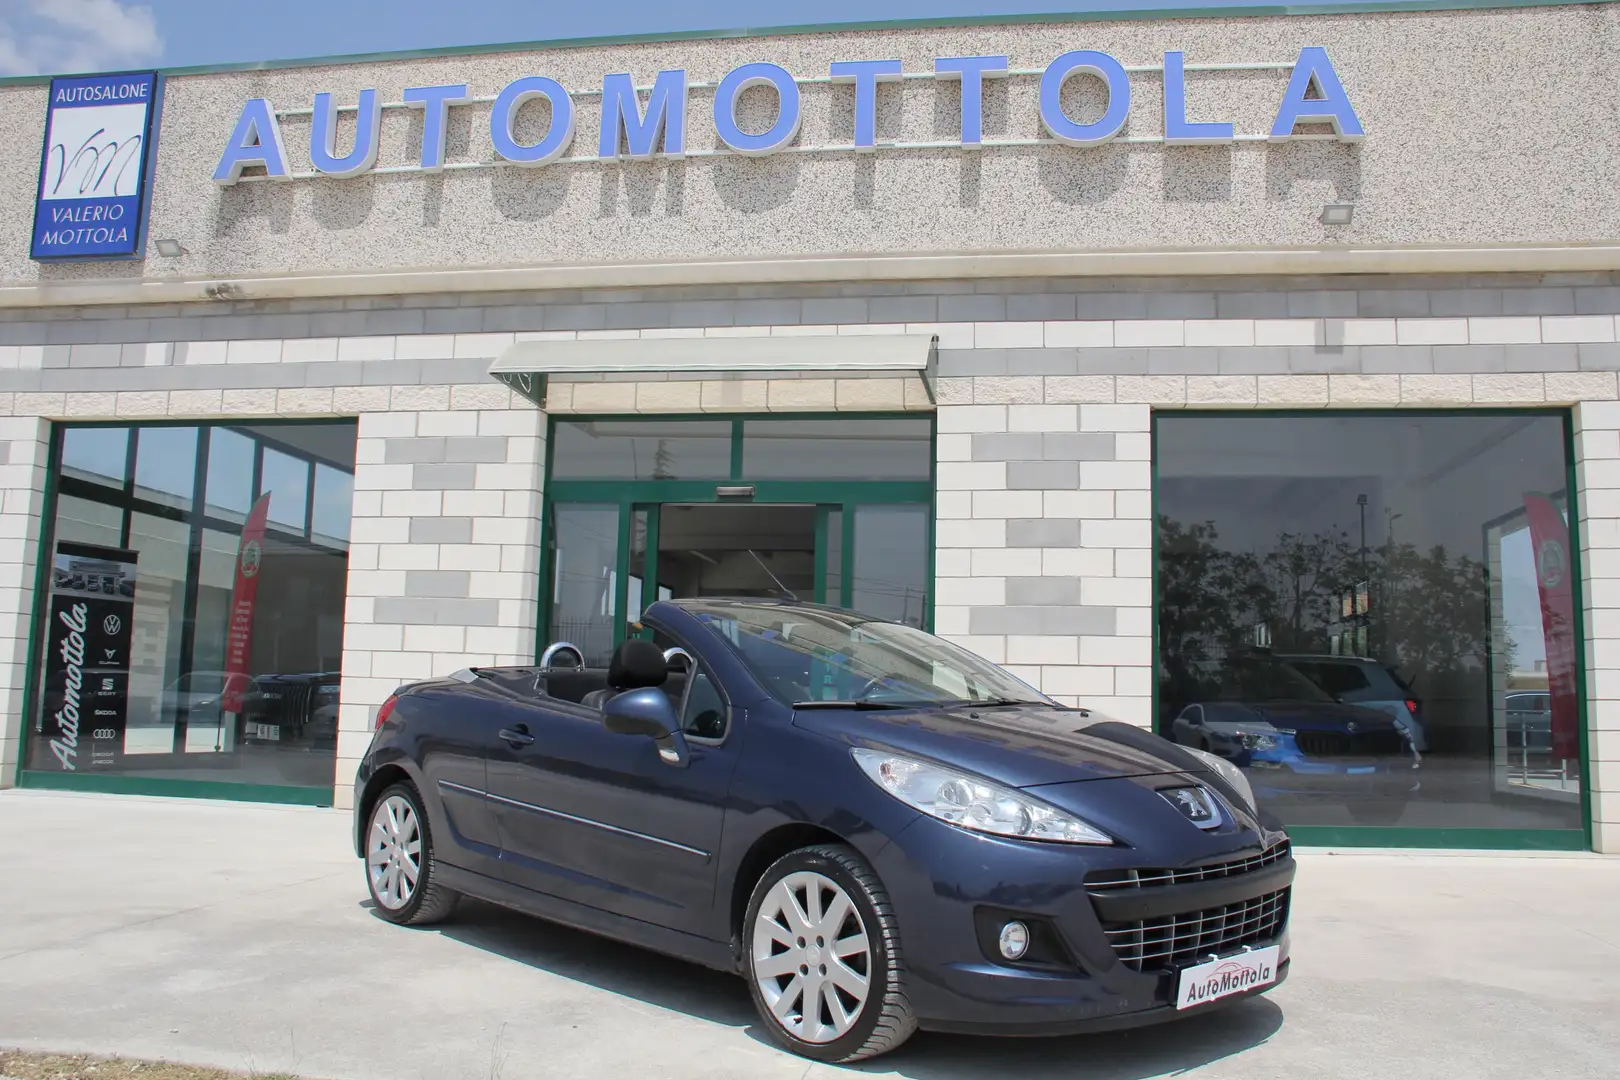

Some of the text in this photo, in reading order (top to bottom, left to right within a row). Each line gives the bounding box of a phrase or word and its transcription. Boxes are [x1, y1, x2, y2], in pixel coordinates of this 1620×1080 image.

[56, 83, 149, 103] AUTOSALONE
[212, 46, 1366, 186] AUTOMOTTOLA
[52, 204, 124, 223] VALERIO
[41, 227, 128, 246] MOTTOLA
[49, 602, 88, 771] Automottola
[1186, 962, 1271, 1003] AutoMottola
